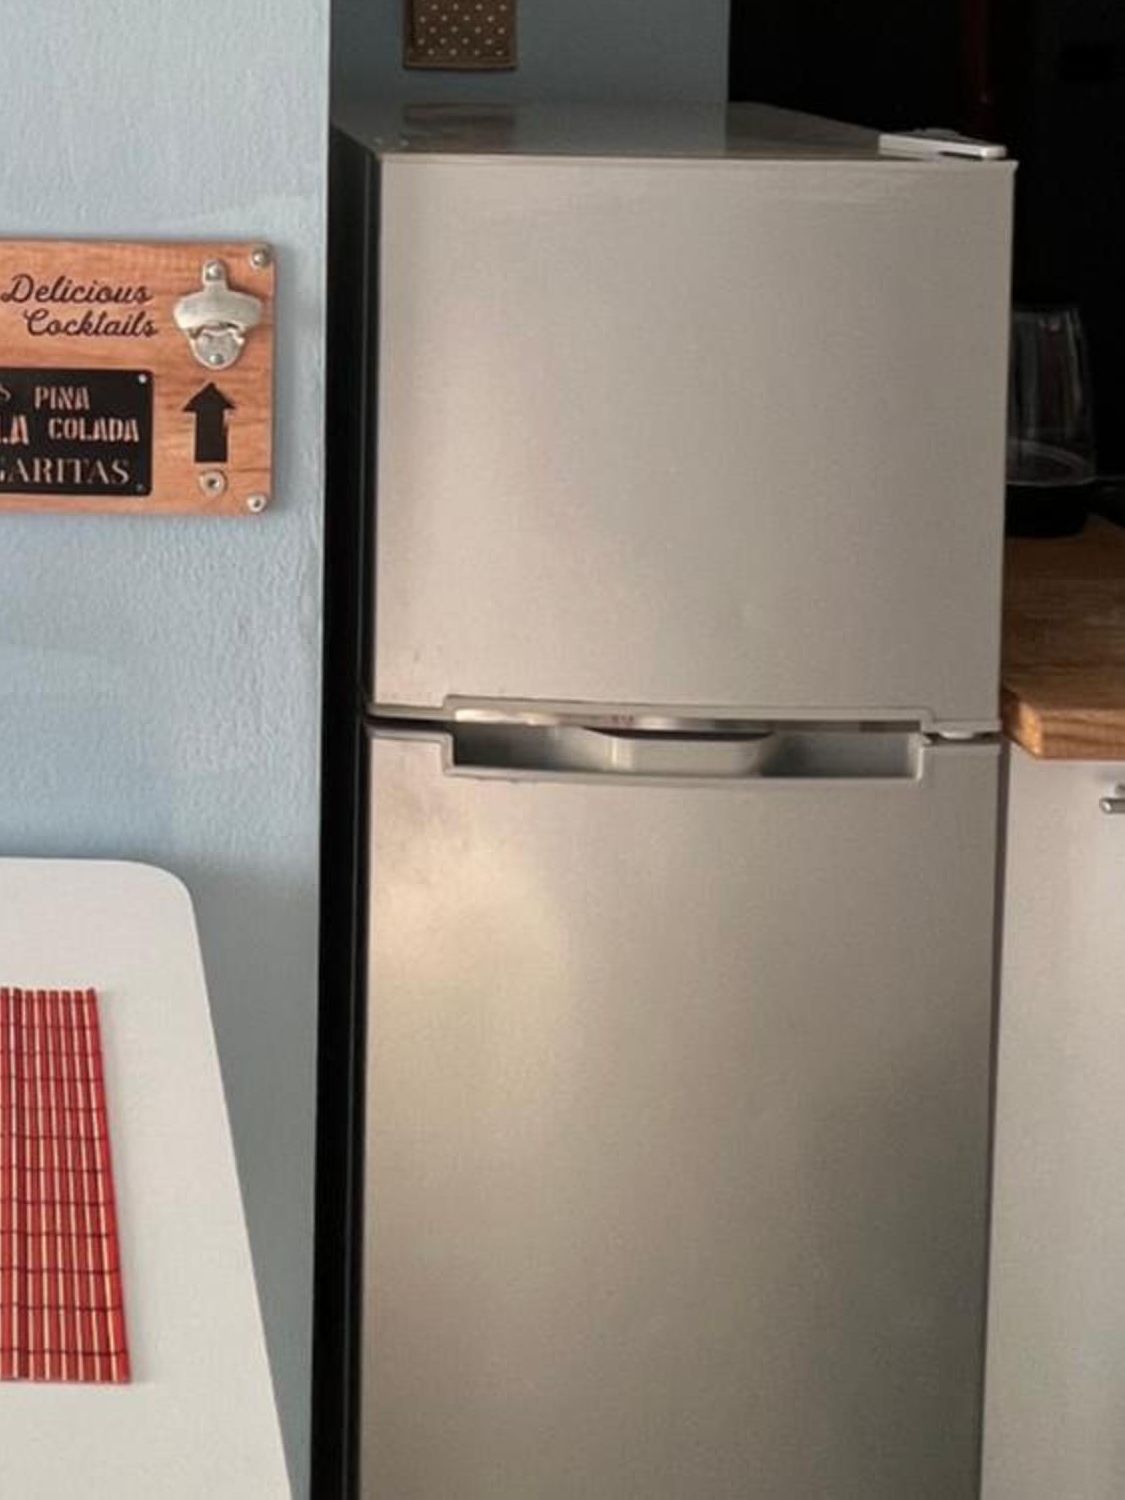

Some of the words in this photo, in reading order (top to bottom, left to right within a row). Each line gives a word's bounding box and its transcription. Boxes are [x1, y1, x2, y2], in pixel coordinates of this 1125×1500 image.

[0, 272, 154, 305] Delicious
[23, 307, 160, 338] Cocktails
[33, 385, 92, 411] PINA
[47, 416, 141, 443] COLADA
